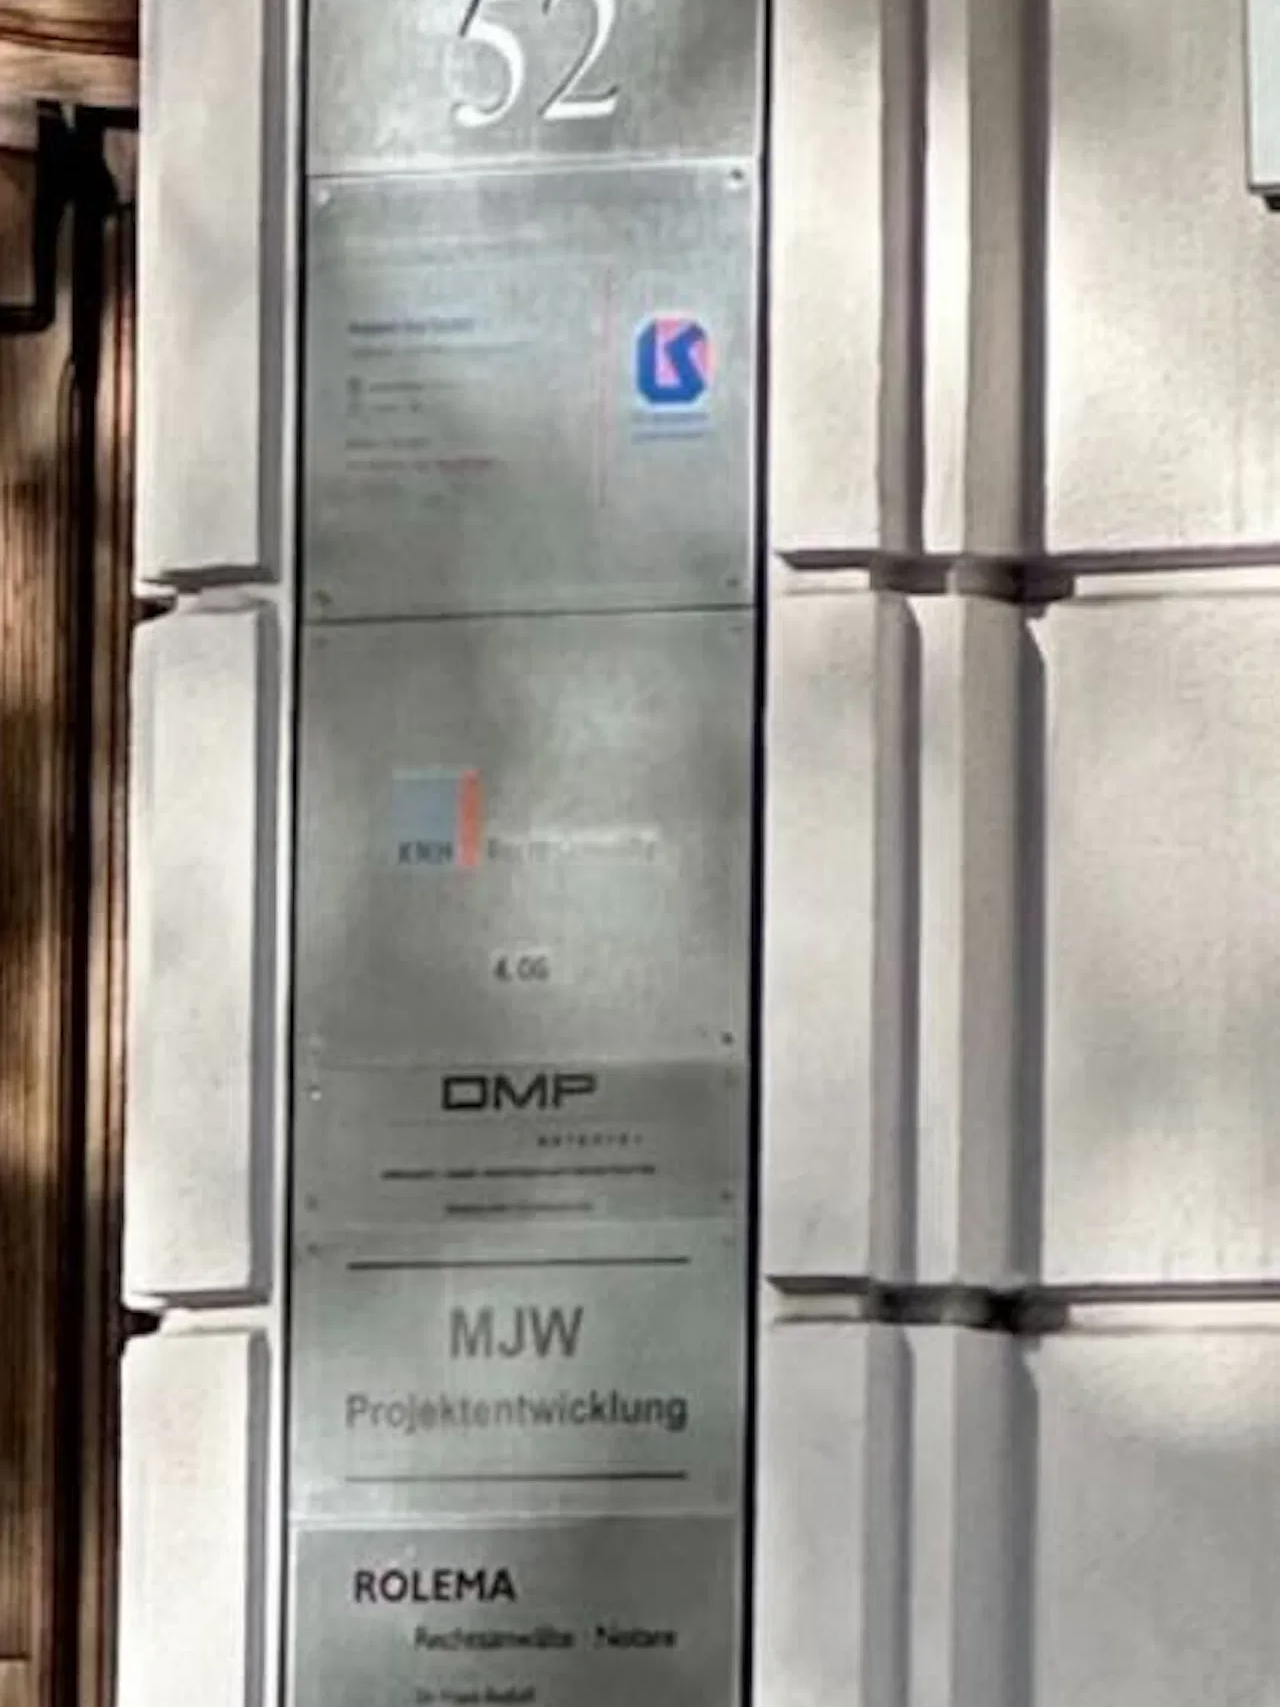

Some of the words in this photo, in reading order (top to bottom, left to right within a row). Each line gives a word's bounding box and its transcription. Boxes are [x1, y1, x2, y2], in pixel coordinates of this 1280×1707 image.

[451, 1304, 585, 1359] MJW
[345, 1390, 689, 1434] Projektentwicklung
[354, 1567, 517, 1603] ROLEMA
